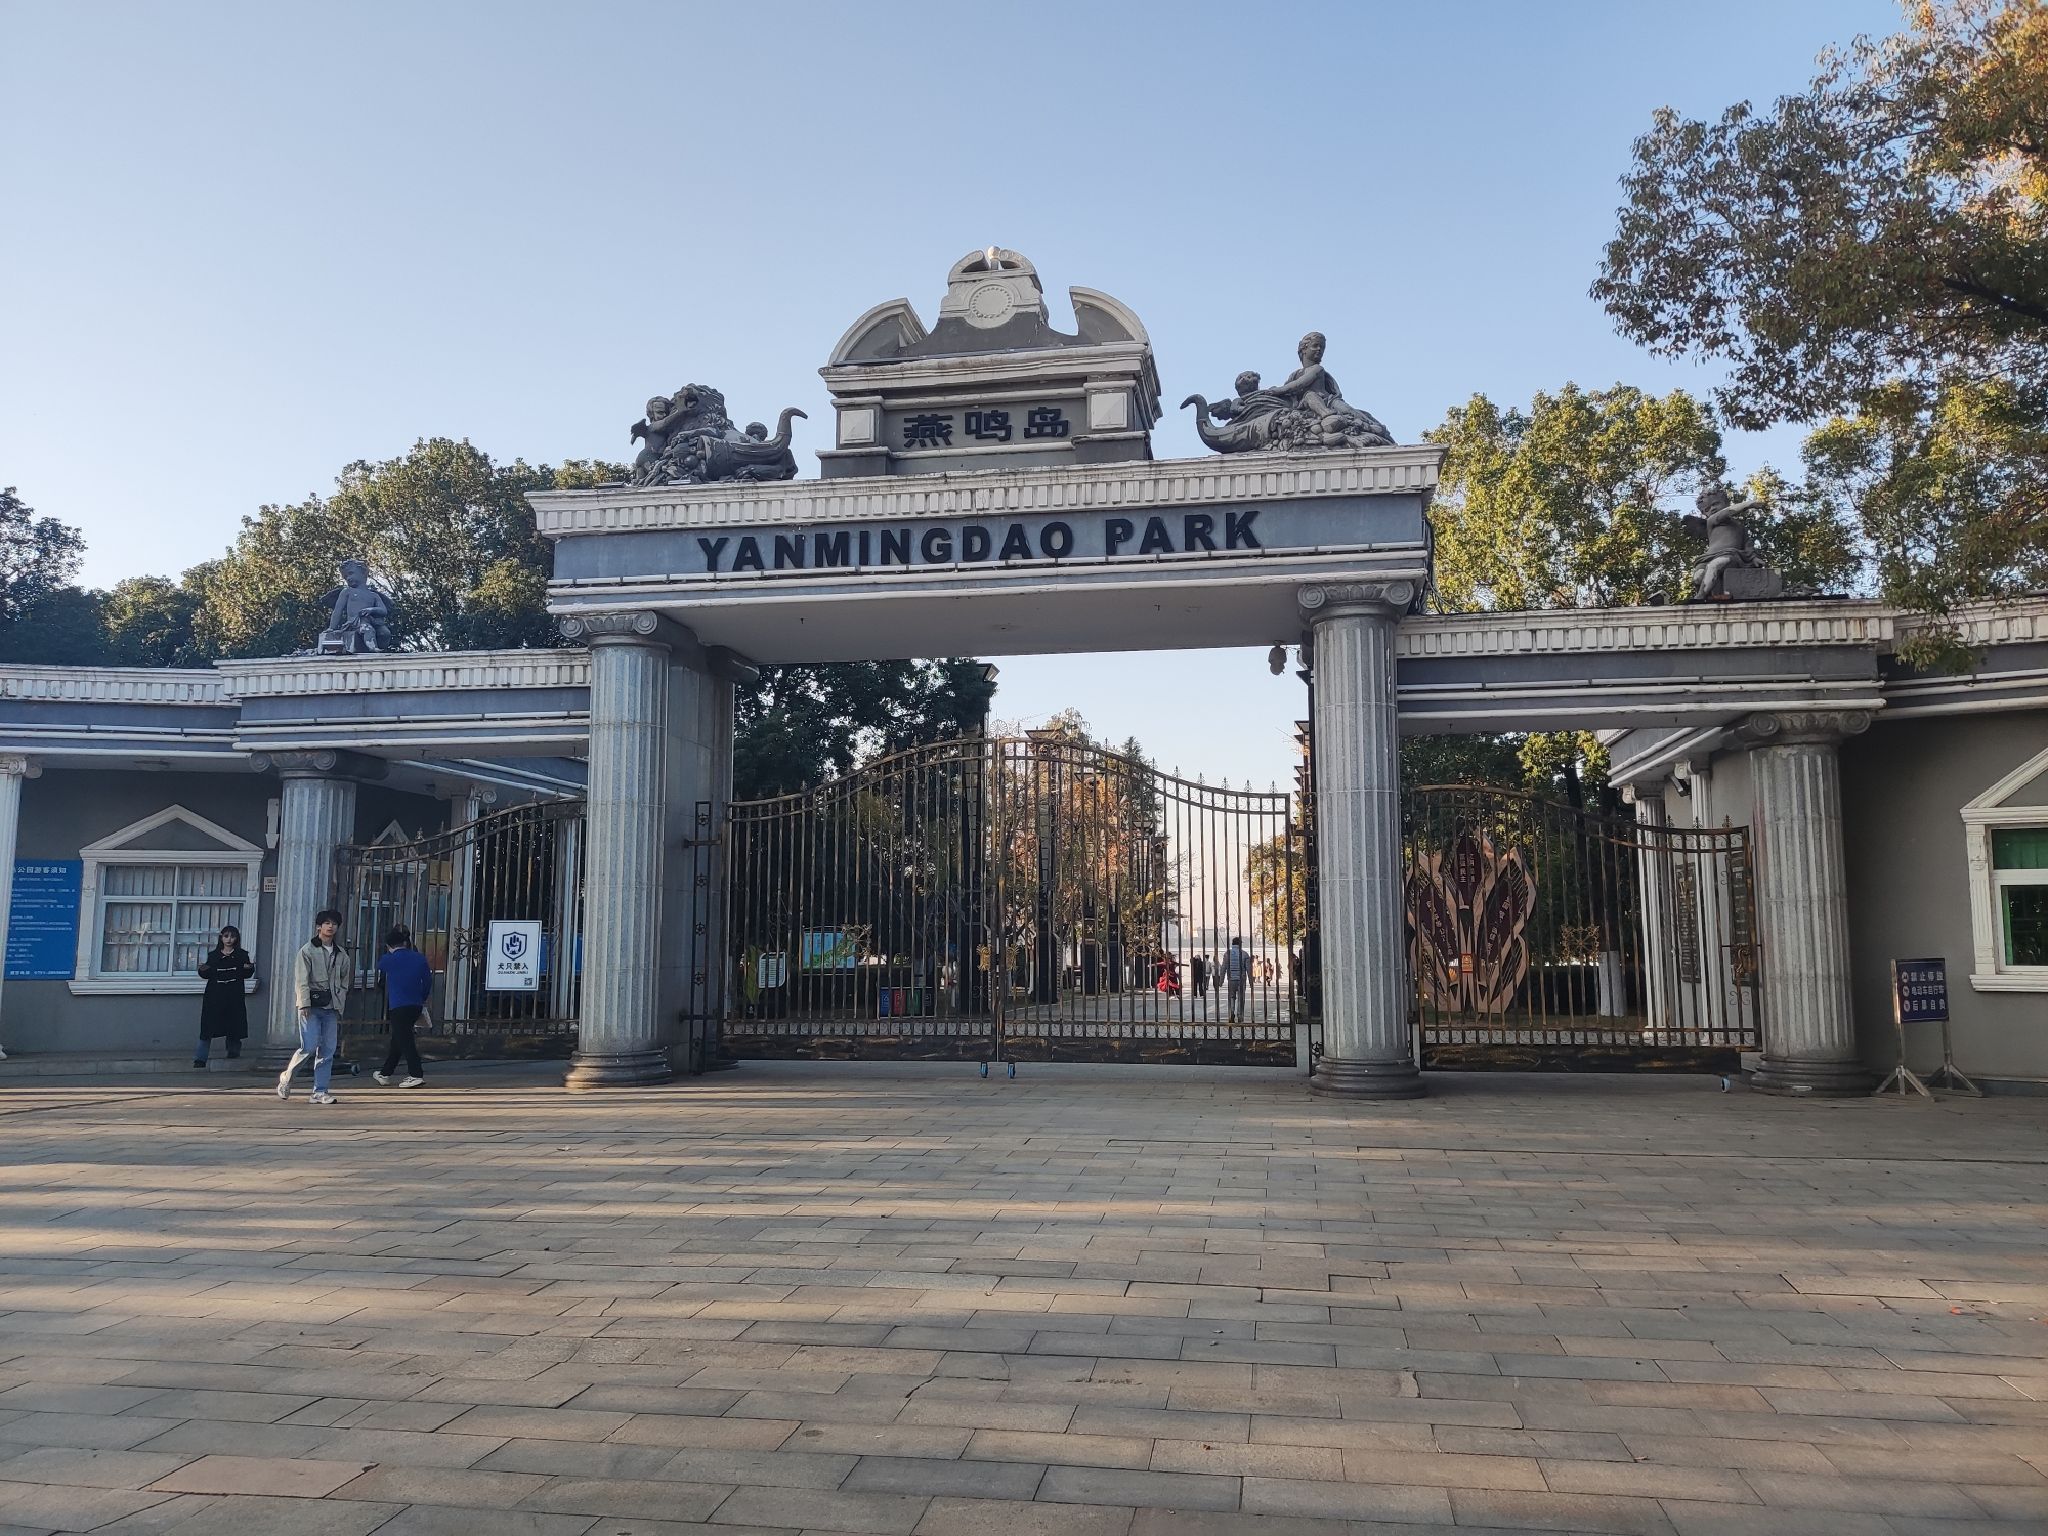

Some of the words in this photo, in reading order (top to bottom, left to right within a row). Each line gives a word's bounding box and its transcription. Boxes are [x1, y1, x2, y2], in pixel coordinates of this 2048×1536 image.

[904, 407, 1068, 447] 燕鸣岛
[698, 521, 1074, 572] YANMINGDAO
[1105, 510, 1262, 556] PARK
[14, 866, 67, 874] 公园游客须知
[497, 962, 529, 970] 犬只禁入
